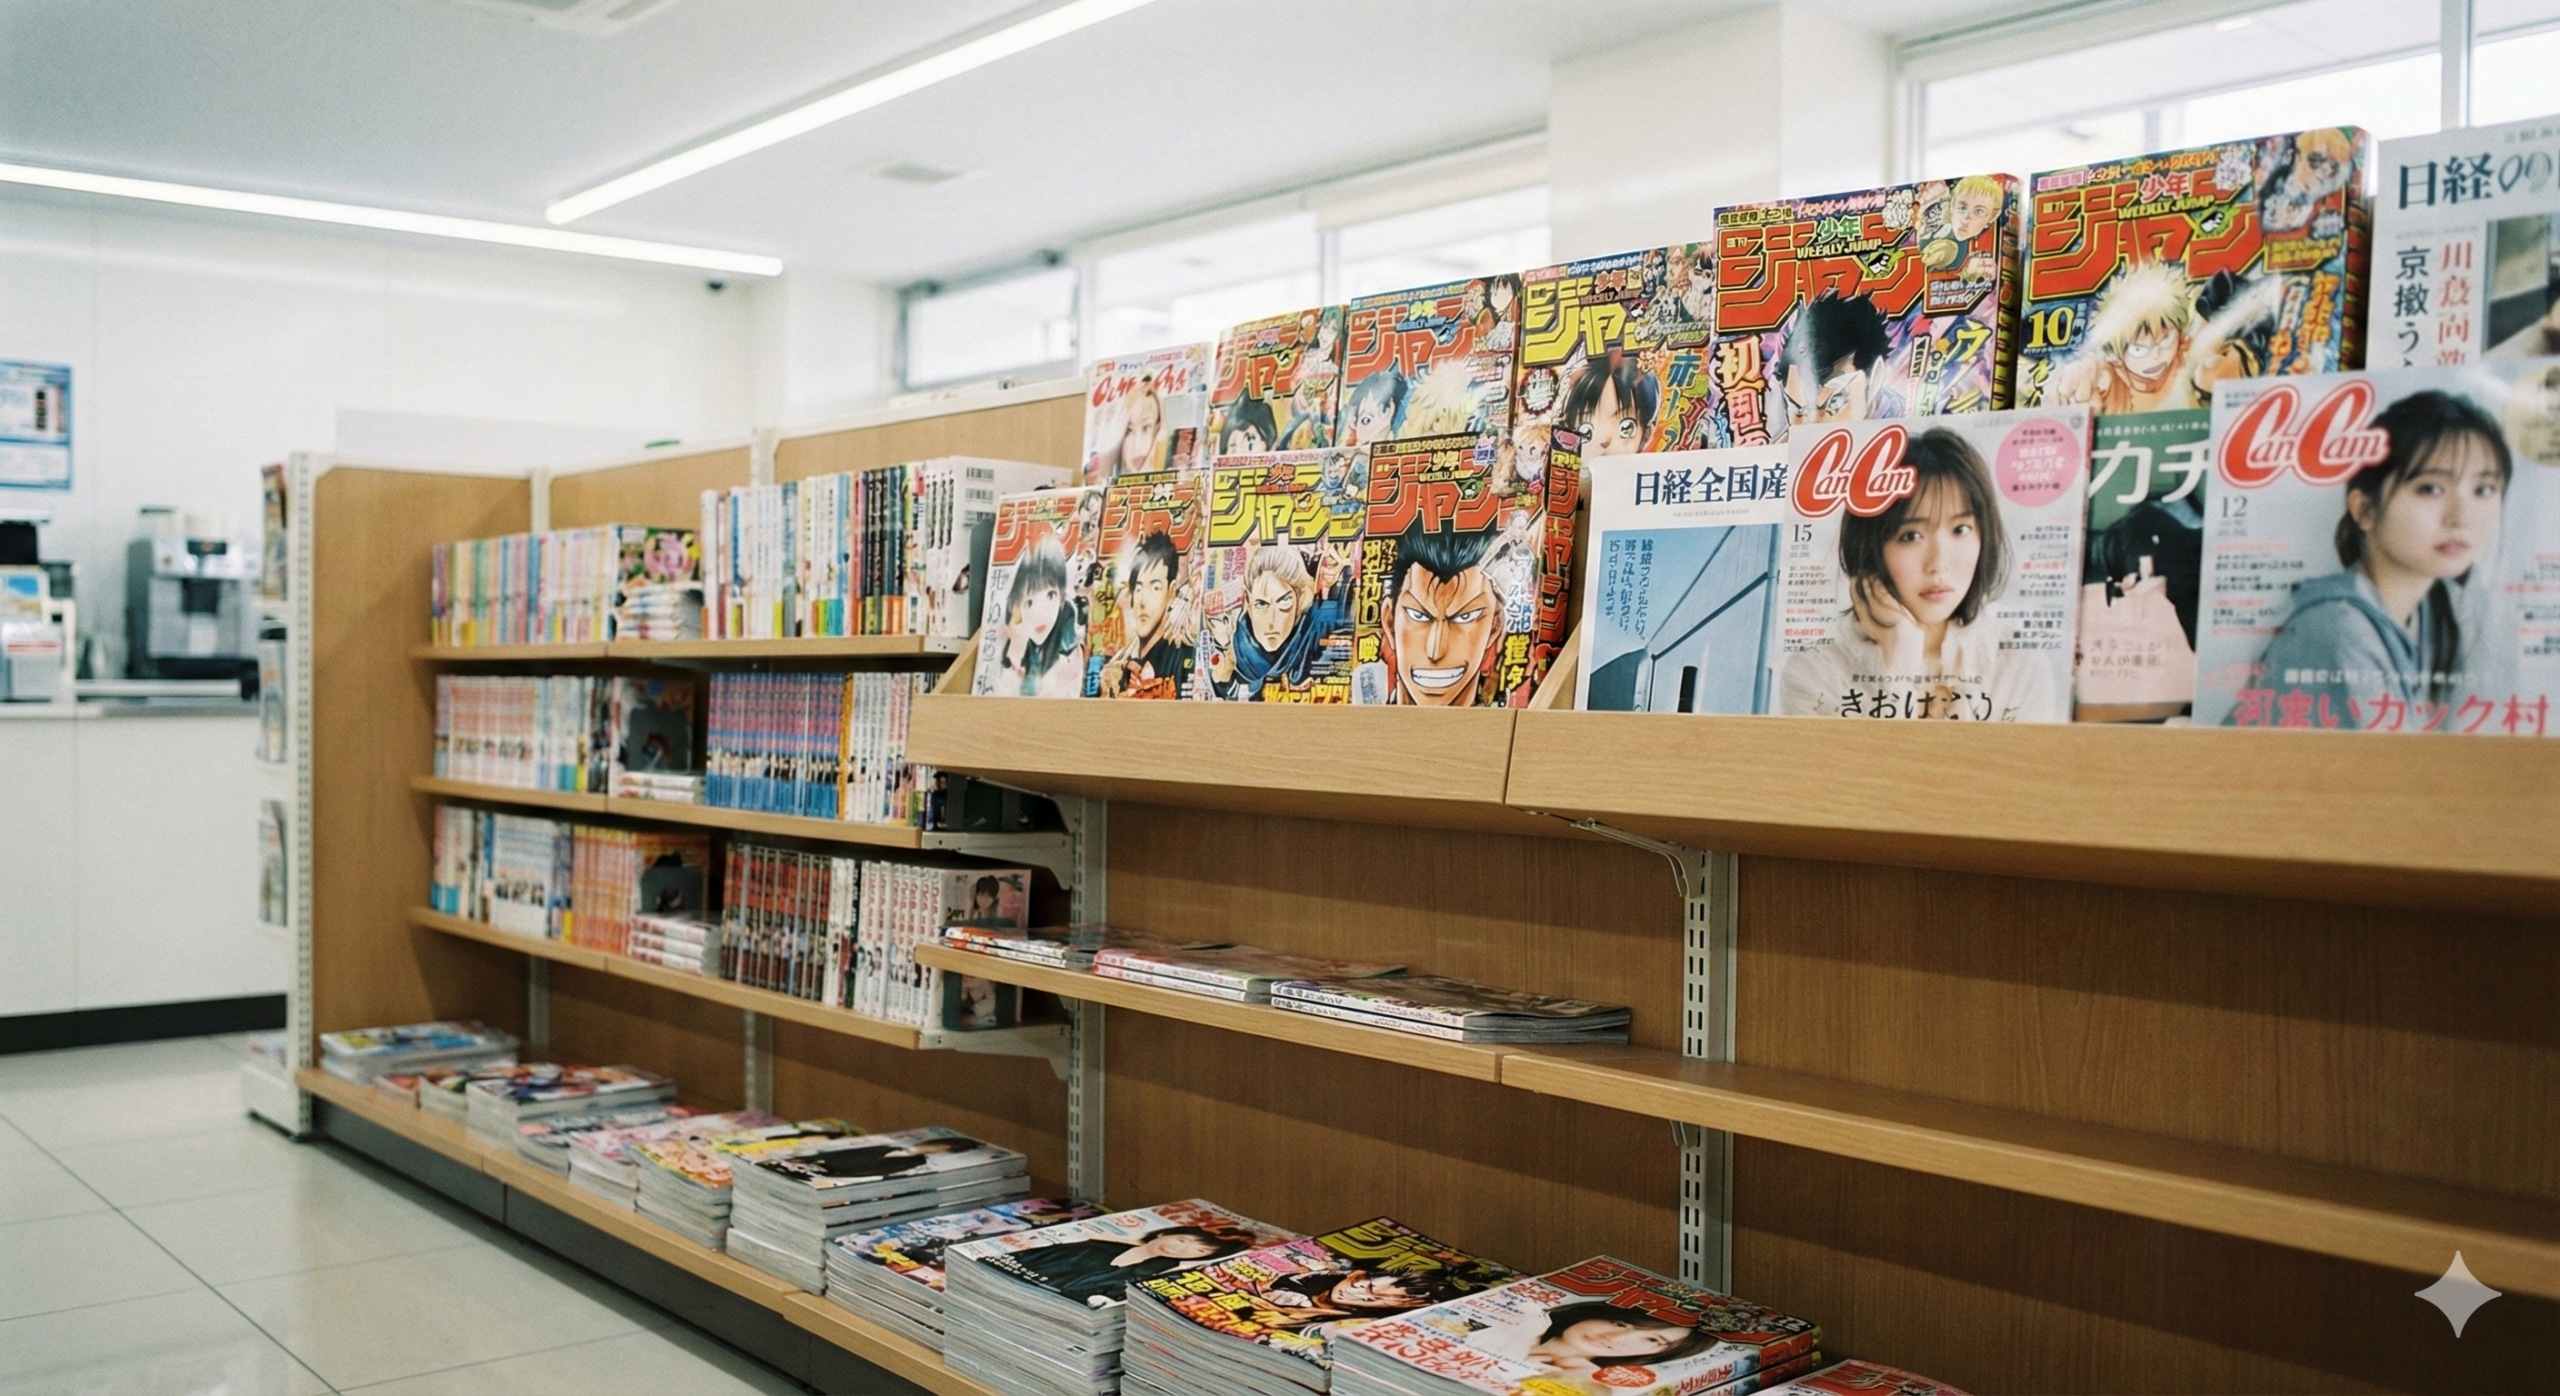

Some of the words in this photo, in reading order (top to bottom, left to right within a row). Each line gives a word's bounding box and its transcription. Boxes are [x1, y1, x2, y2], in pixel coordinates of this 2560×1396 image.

[2140, 173, 2189, 204] 少年
[2399, 152, 2560, 210] 日経の
[1817, 215, 1861, 242] 少年
[1843, 238, 1882, 254] JUMP
[2030, 306, 2073, 349] 10
[2218, 380, 2391, 489] CanCam
[1635, 463, 1789, 506] 日経全国産
[1791, 424, 1919, 518] CanCam
[2222, 497, 2248, 518] 12
[1793, 523, 1813, 542] 15
